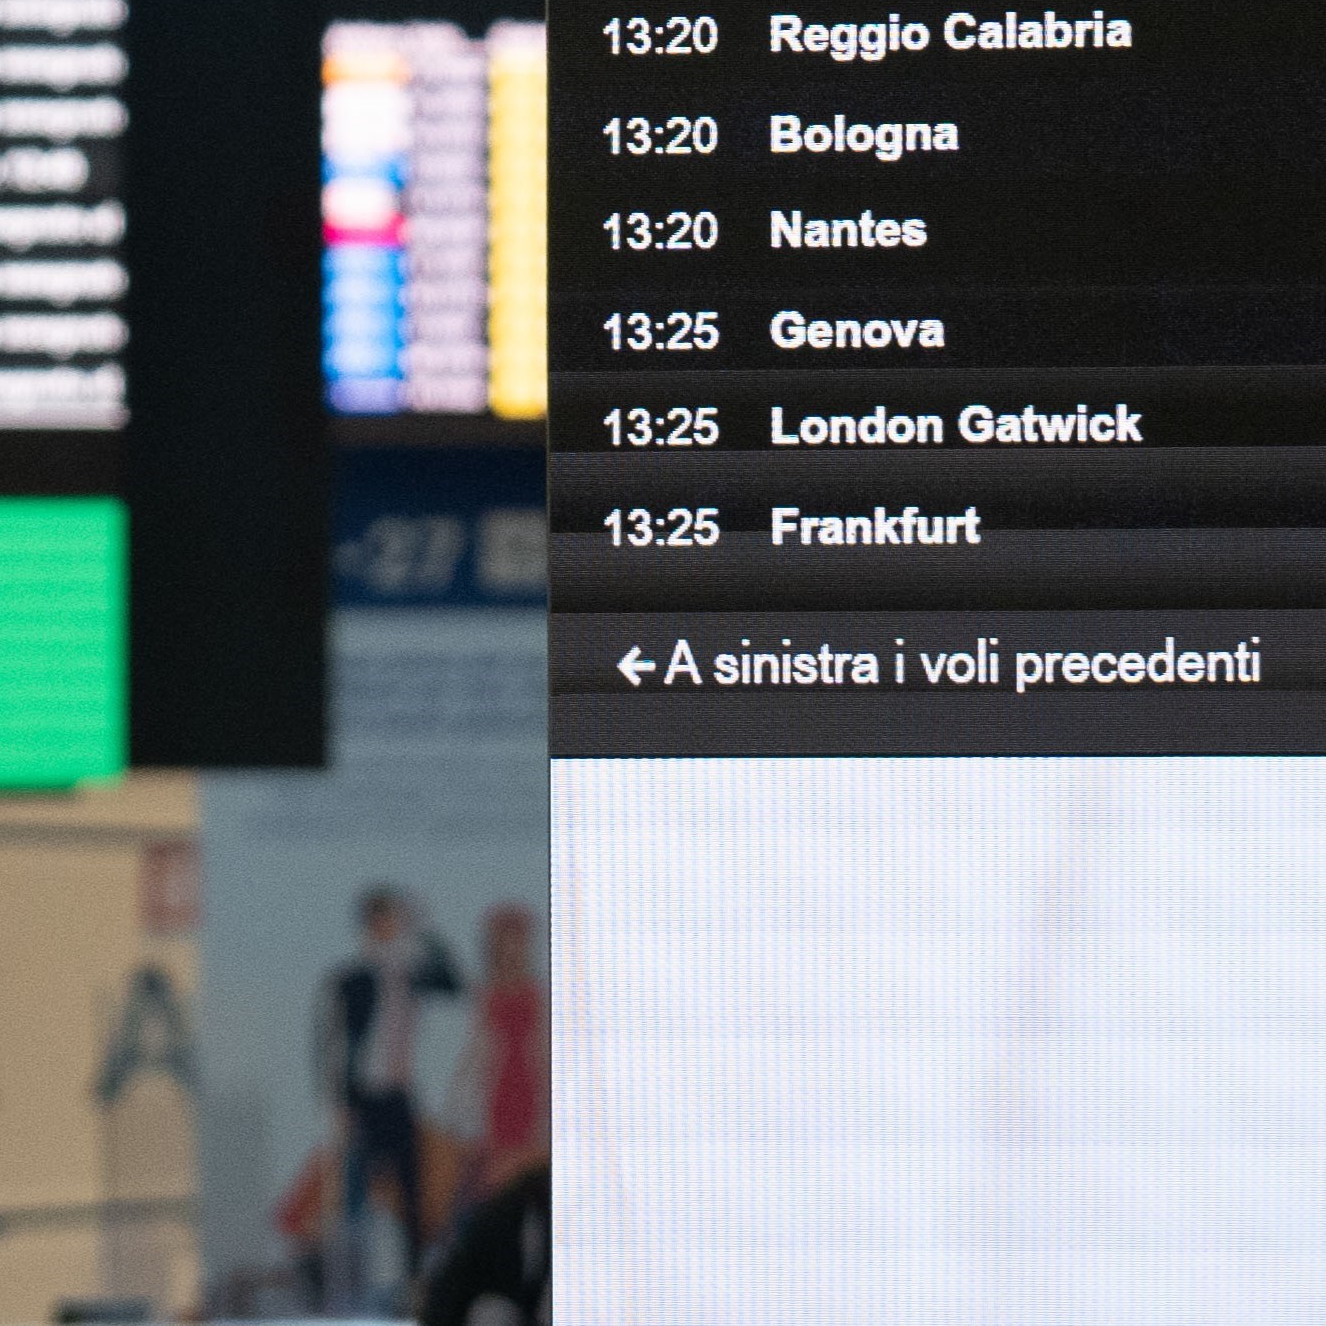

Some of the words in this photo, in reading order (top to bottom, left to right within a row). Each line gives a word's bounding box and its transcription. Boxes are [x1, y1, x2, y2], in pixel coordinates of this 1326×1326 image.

[603, 16, 718, 54] 13:20
[770, 14, 930, 61] Reggio
[944, 10, 1132, 49] Calabria
[603, 117, 718, 154] 13:20
[771, 115, 959, 161] Bologna
[604, 212, 718, 250] 13:20
[771, 210, 927, 248] Nantes
[604, 312, 719, 350] 13:25
[770, 311, 944, 348] Genova
[604, 407, 719, 445] 13:25
[772, 406, 943, 444] London
[958, 404, 1143, 442] Gatwick
[604, 508, 720, 546] 13:25
[772, 507, 981, 545] Frankfurt
[664, 640, 702, 684] A
[714, 639, 879, 685] sinistra
[895, 638, 904, 684] i
[920, 638, 998, 684] voli
[1016, 637, 1260, 693] precedenti
